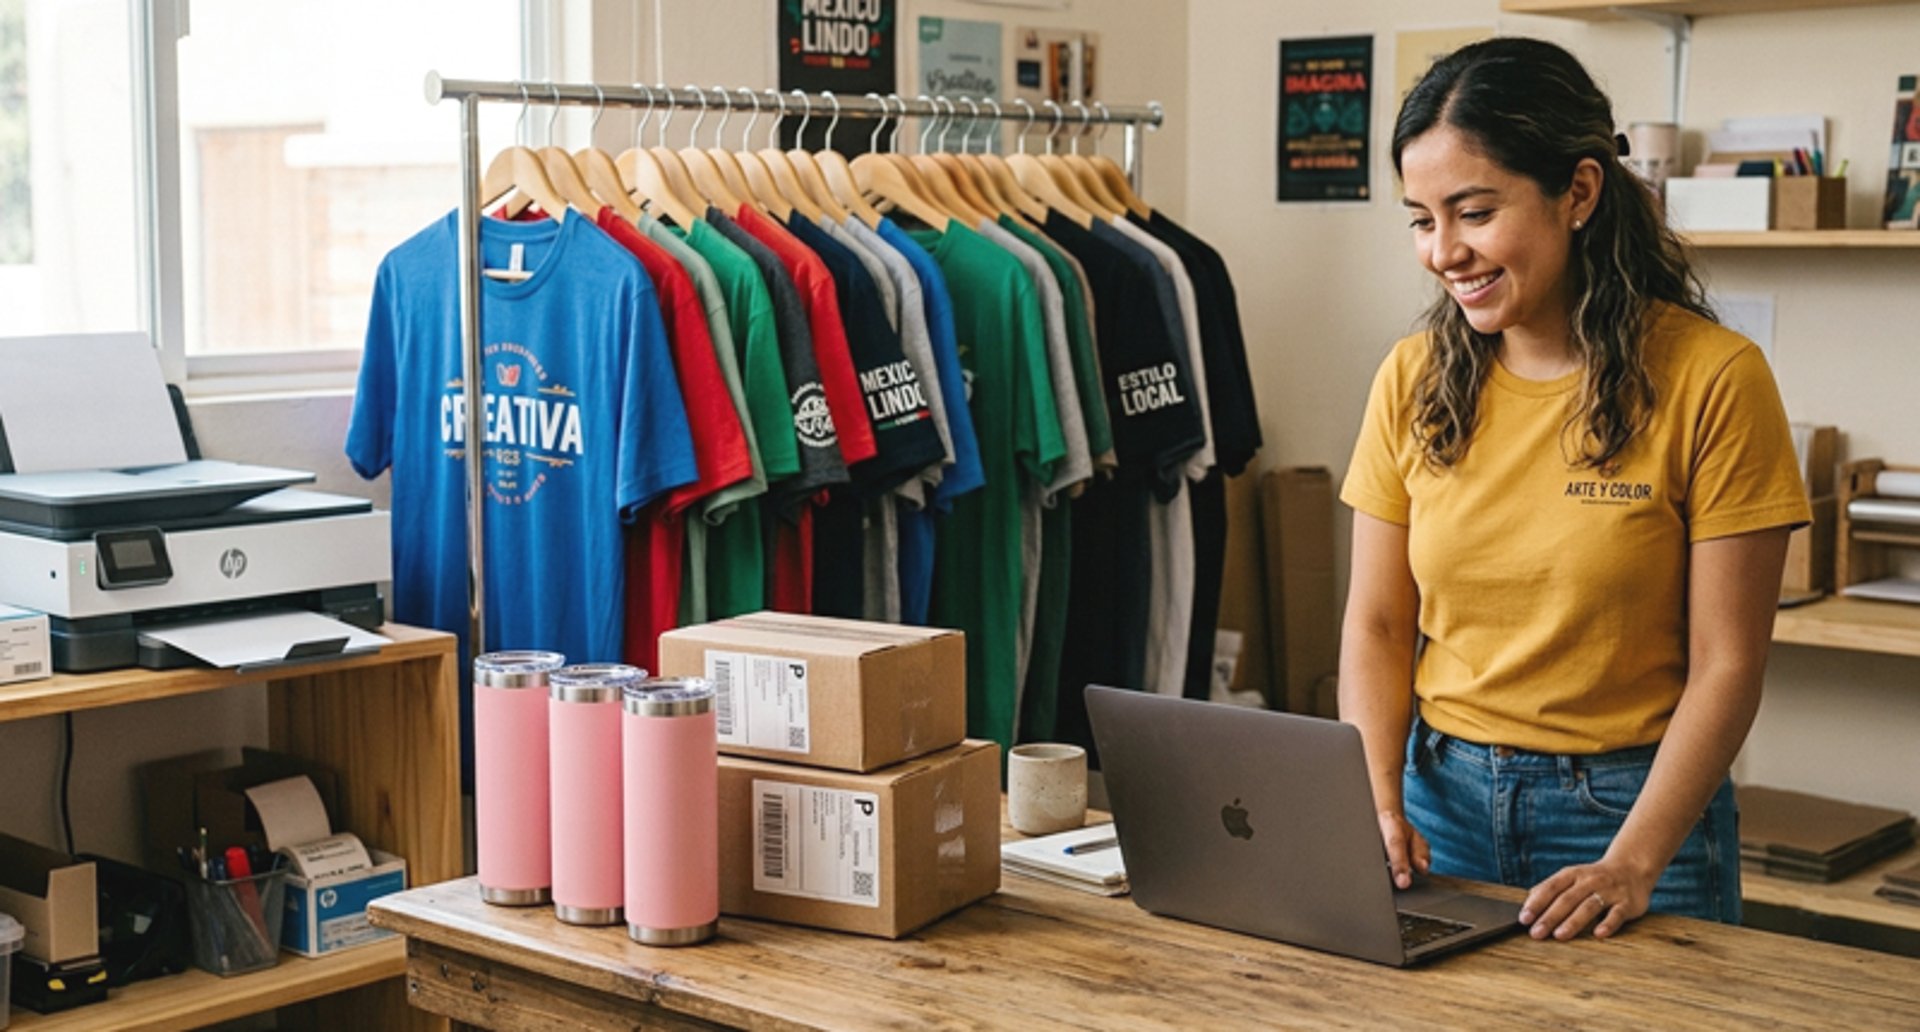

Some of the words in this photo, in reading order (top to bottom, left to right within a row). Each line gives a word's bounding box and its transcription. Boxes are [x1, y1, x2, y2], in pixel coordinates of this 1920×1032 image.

[802, 20, 868, 55] LINDO
[860, 360, 916, 393] MEXIC
[1118, 362, 1176, 390] ESTILO
[1121, 380, 1184, 416] LOCAL
[441, 393, 584, 455] CREATIVA
[1564, 482, 1597, 497] ARTE
[1600, 482, 1608, 497] Y
[1610, 482, 1652, 499] COLOR
[221, 548, 247, 579] hp
